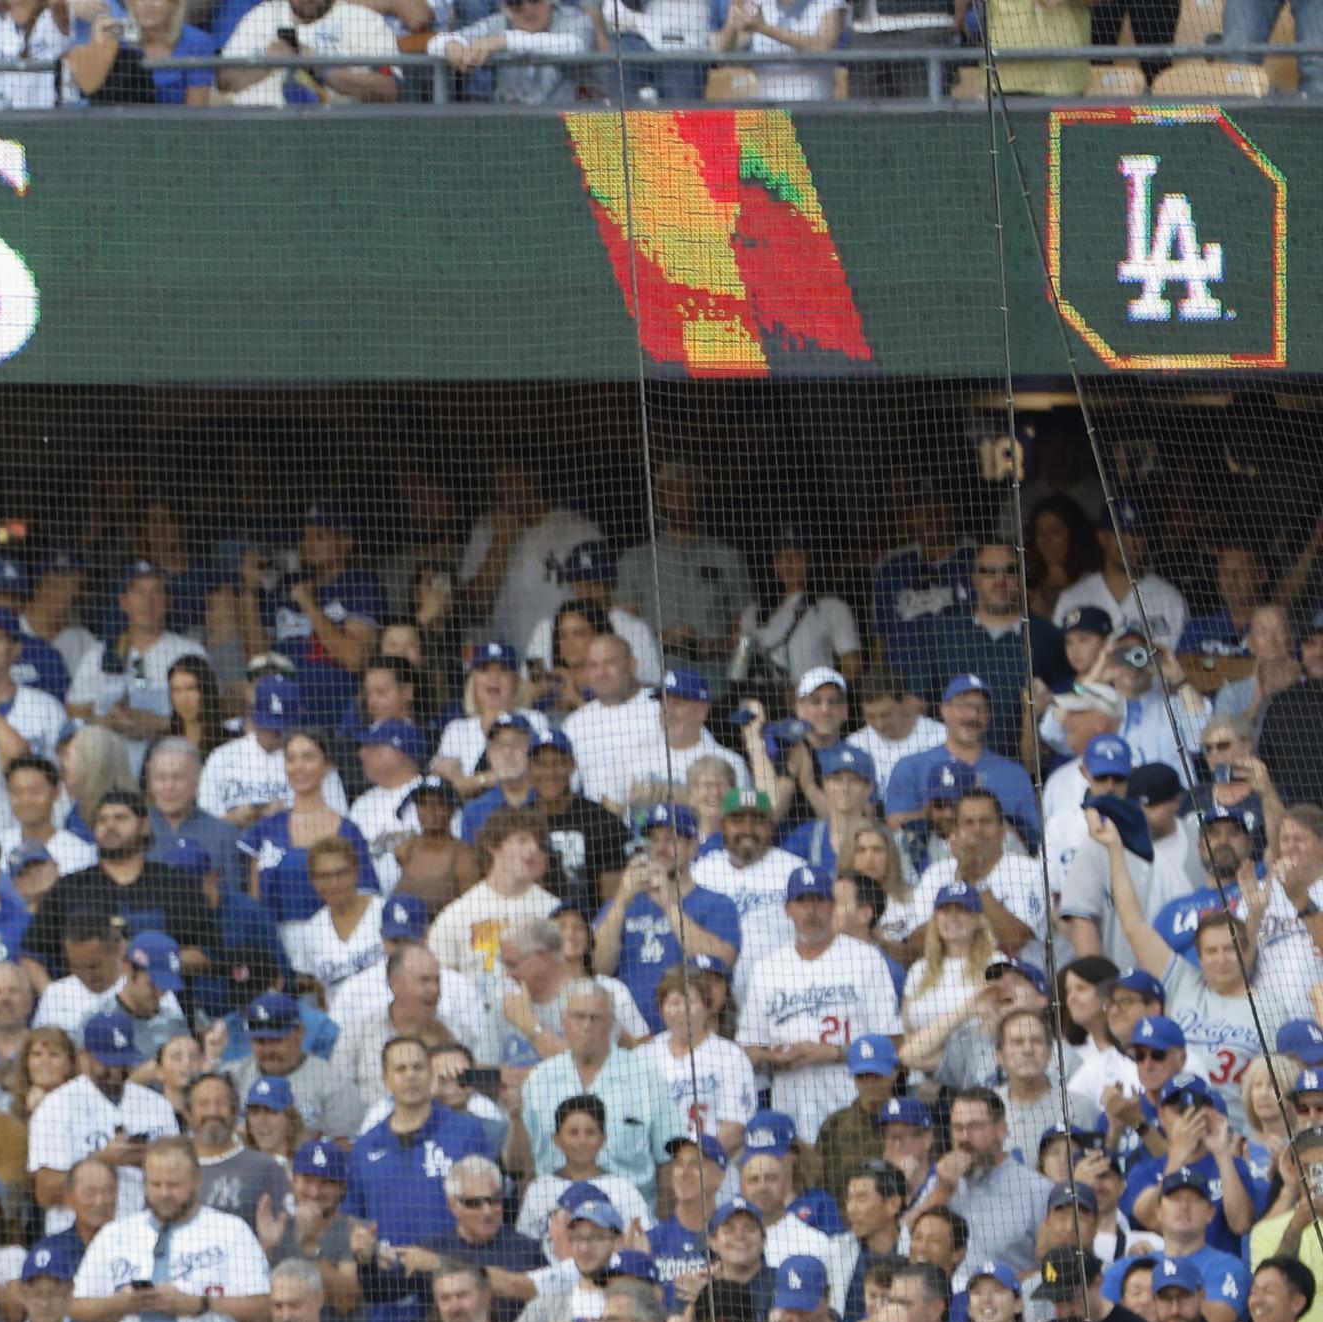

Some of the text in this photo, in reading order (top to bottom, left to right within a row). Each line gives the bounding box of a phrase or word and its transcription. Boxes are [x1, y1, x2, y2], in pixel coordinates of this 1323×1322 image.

[1117, 154, 1225, 322] LA
[769, 985, 857, 1025] Dodgers
[1175, 1008, 1262, 1053] Dodgers
